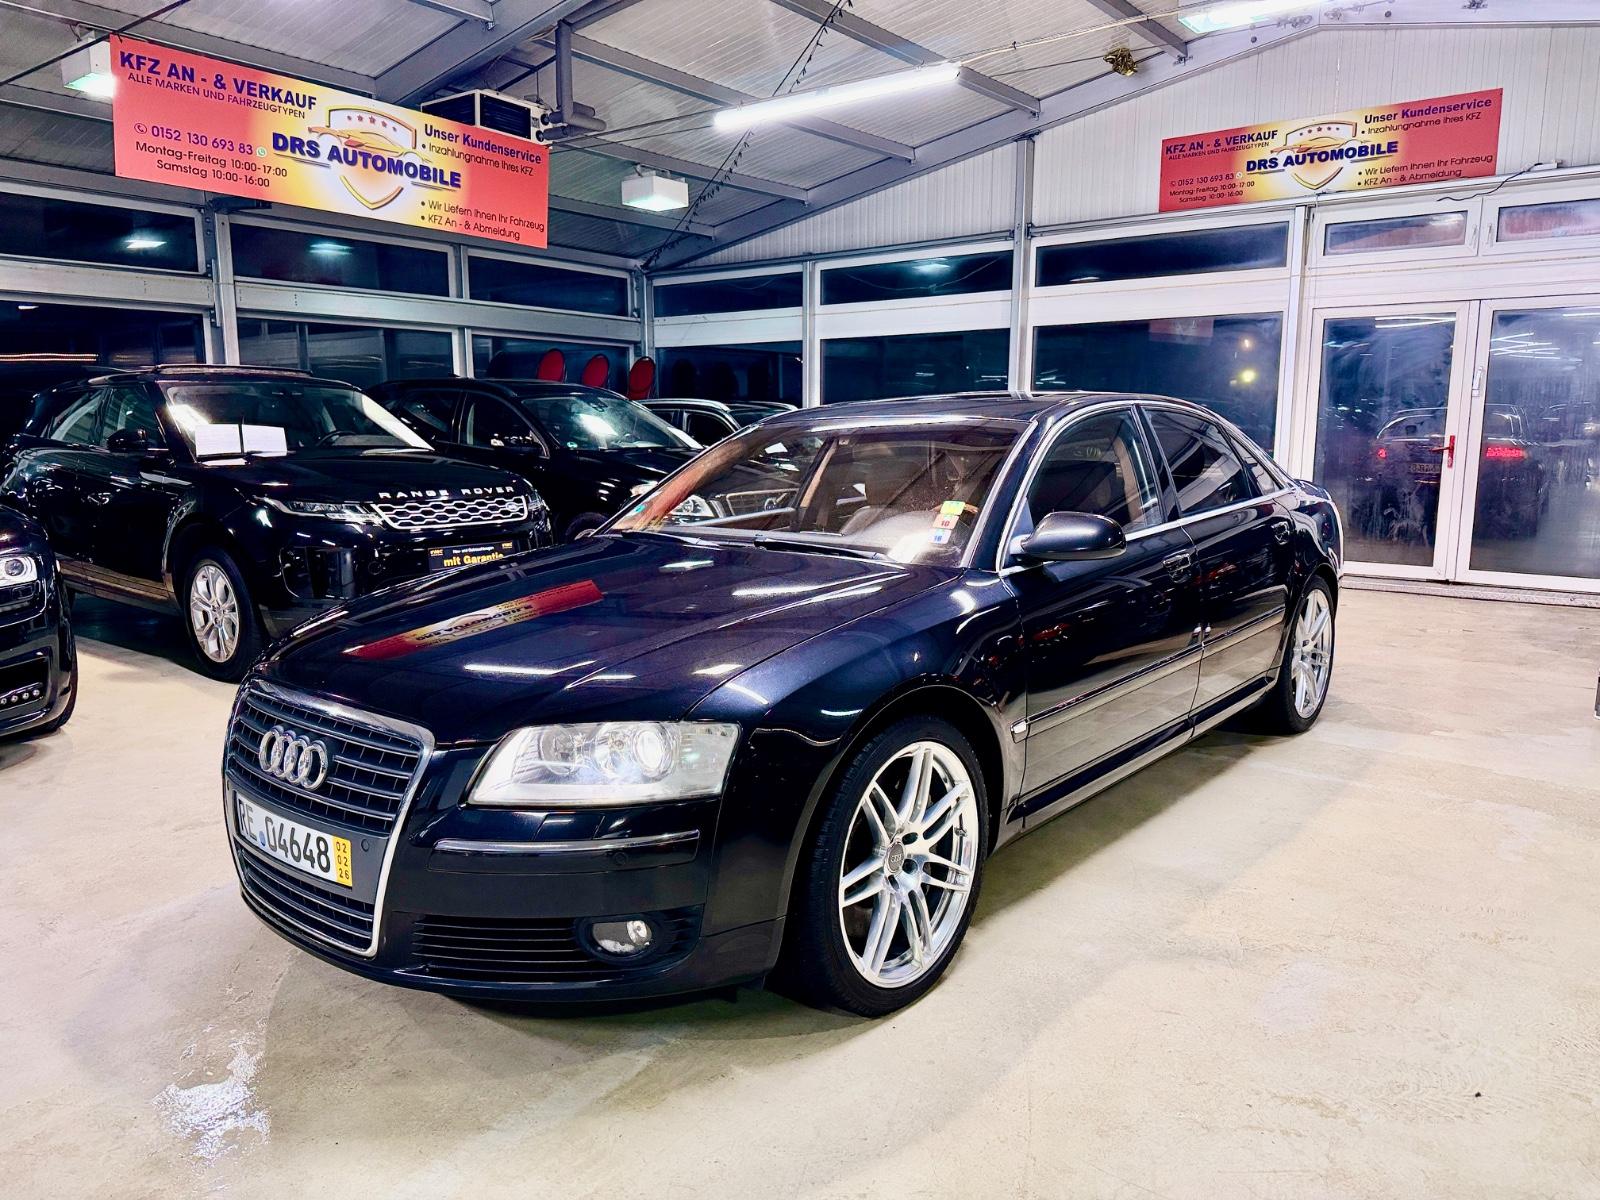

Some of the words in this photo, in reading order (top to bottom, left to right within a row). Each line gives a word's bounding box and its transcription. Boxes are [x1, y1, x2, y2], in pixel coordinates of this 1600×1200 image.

[120, 51, 160, 75] KFZ
[168, 63, 194, 82] AN
[214, 74, 226, 90] &
[233, 78, 317, 110] VERKAUF
[128, 72, 152, 85] ALLE
[156, 78, 200, 96] MARKEN
[203, 89, 225, 101] UND
[228, 94, 305, 119] FAHRZEUGTYPEN
[1364, 113, 1398, 124] Unser
[1401, 98, 1492, 119] Kundenservice
[1368, 118, 1441, 135] Inzahlungnahme
[1443, 115, 1463, 124] Ihres
[1466, 112, 1481, 121] KFZ
[151, 125, 181, 141] 0152
[187, 132, 208, 146] 130
[212, 138, 234, 152] 693
[239, 143, 253, 155] 83
[424, 124, 459, 143] Unser
[463, 134, 542, 164] Kundenservice
[1166, 144, 1186, 154] KFZ
[1189, 141, 1204, 151] AN
[1214, 138, 1221, 147] &
[1226, 130, 1278, 146] VERKAUF
[1182, 151, 1206, 159] MARKEN
[1221, 141, 1269, 154] FAHRZEUGTYPEN
[135, 141, 226, 168] Montag-Freitag
[231, 158, 287, 177] 10:00-17:00
[272, 133, 320, 158] DRS
[327, 145, 461, 188] AUTOMOBILE
[429, 143, 500, 168] Inzahlungnahme
[502, 160, 519, 173] Ihres
[521, 165, 534, 176] KFZ
[1246, 157, 1278, 172] DRS
[1283, 141, 1399, 167] AUTOMOBILE
[1365, 167, 1378, 176] Wir
[1380, 163, 1409, 174] Liefern
[1410, 161, 1434, 171] Ihnen
[1437, 159, 1448, 167] Ihr
[1450, 155, 1493, 166] Fahrzeug
[157, 160, 208, 178] Samstag
[212, 169, 270, 187] 10:00-16:00
[1178, 178, 1194, 186] 0152
[1197, 176, 1208, 184] 130
[1210, 174, 1222, 183] 693
[1364, 178, 1378, 186] KFZ
[1380, 176, 1392, 184] An
[1400, 174, 1407, 182] &
[1409, 169, 1462, 181] Abmeldung
[1179, 194, 1206, 203] Samstag
[428, 201, 442, 210] Wir
[444, 202, 472, 216] Liefern
[474, 209, 496, 221] Ihnen
[498, 214, 508, 224] Ihr
[510, 216, 544, 232] Fahrzeug
[428, 216, 442, 226] KFZ
[444, 218, 457, 227] An
[464, 220, 471, 230] &
[473, 222, 520, 241] Abmeldung
[378, 490, 449, 499] RANGE
[461, 486, 515, 495] ROVER
[444, 556, 461, 567] mit
[463, 552, 504, 564] Garantie
[239, 799, 258, 841] RE
[265, 816, 330, 873] 04648
[336, 842, 347, 853] 02
[337, 855, 348, 867] 02
[338, 868, 349, 880] 26
